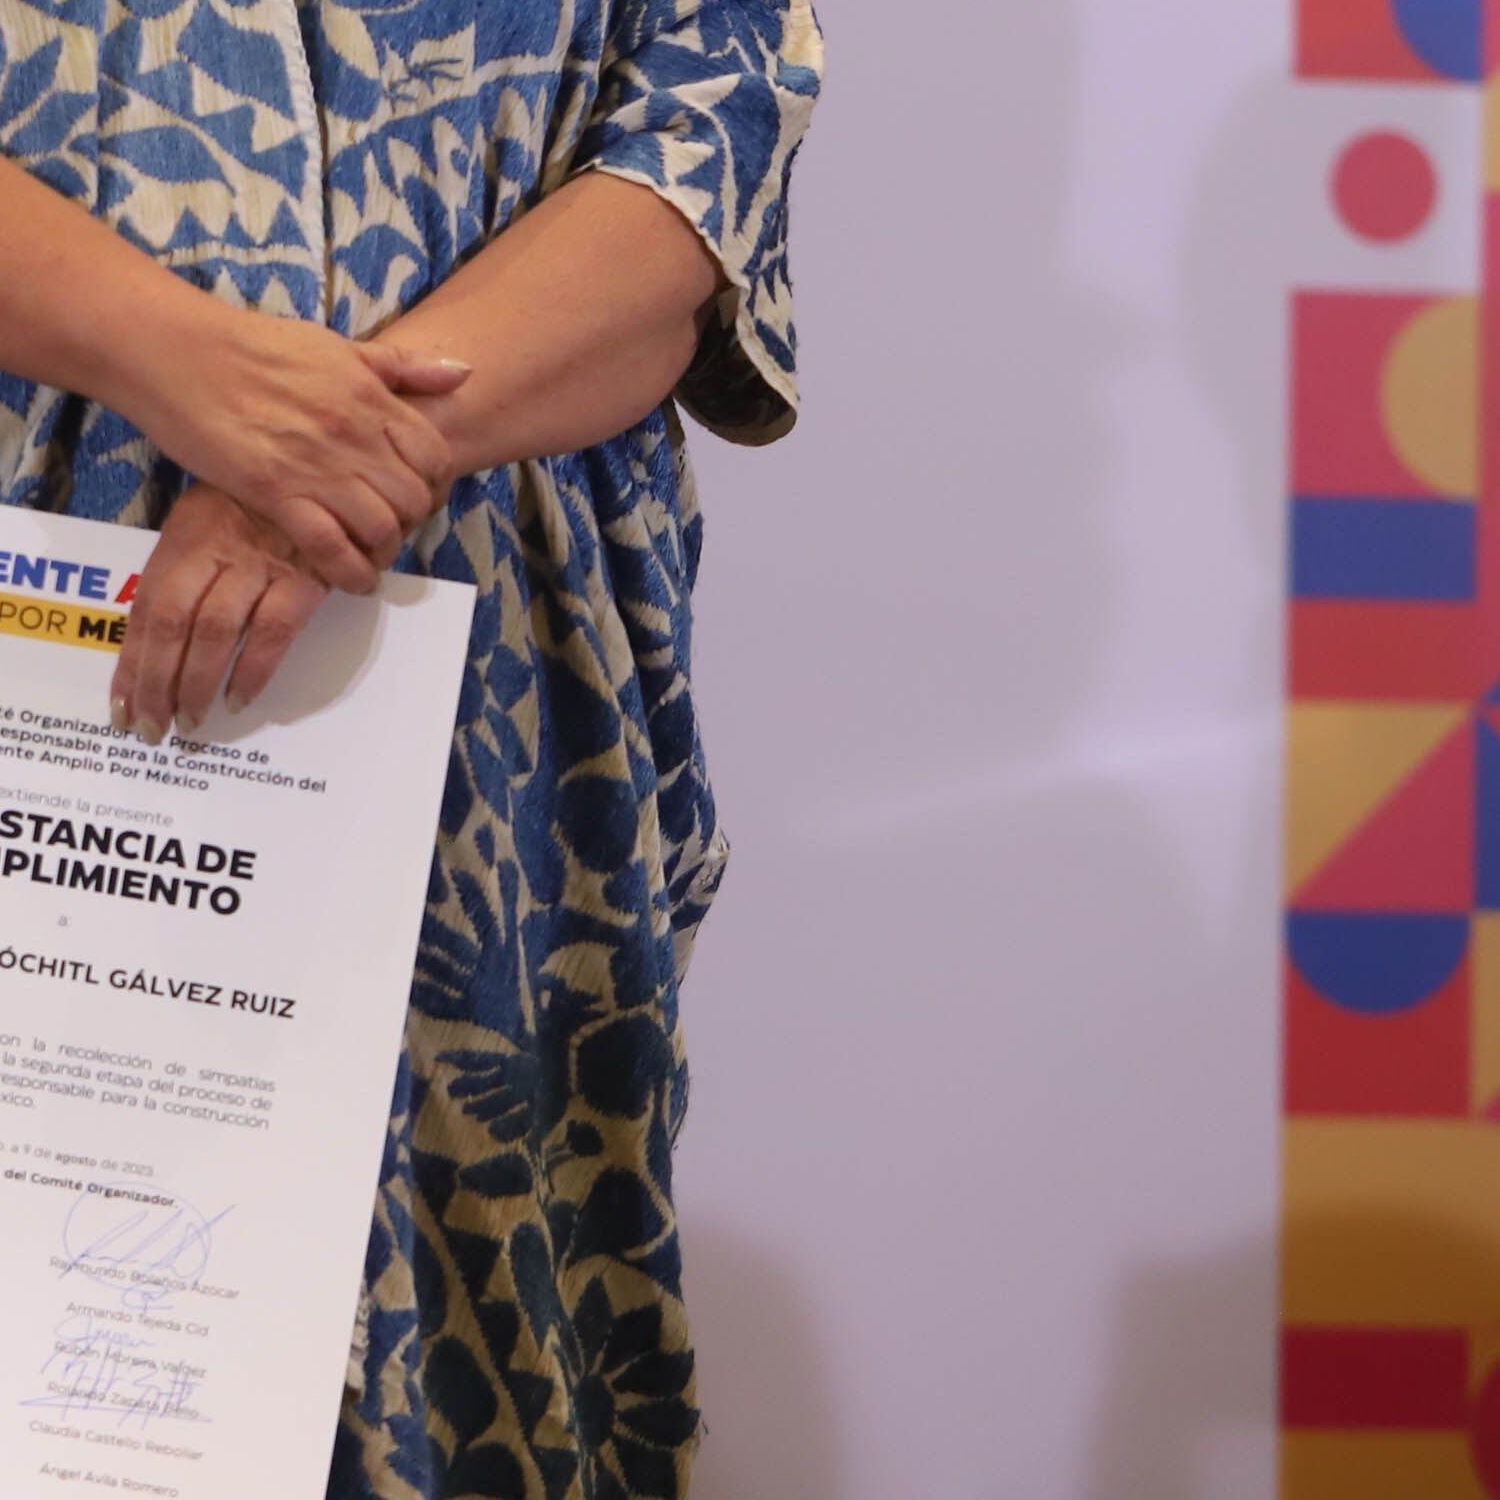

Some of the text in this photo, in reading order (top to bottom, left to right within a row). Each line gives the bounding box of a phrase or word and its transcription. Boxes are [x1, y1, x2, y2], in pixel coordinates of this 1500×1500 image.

[19, 710, 131, 741] Organizador
[169, 735, 243, 760] Proceso
[247, 748, 269, 765] de
[39, 750, 104, 773] Amplio
[109, 762, 140, 779] Por
[145, 768, 209, 792] México
[106, 746, 148, 762] para
[153, 751, 169, 766] la
[174, 755, 294, 787] Construcción
[299, 776, 326, 793] del
[75, 798, 90, 813] la
[94, 804, 173, 828] presente
[195, 842, 257, 880] DE
[108, 967, 222, 1006] GÁLVEZ
[229, 989, 296, 1019] RUIZ
[33, 1037, 46, 1052] la
[58, 1044, 152, 1070] recolección
[164, 1059, 186, 1076] de
[2, 1051, 16, 1066] la
[21, 1058, 91, 1079] segunda
[96, 1070, 143, 1090] etapa
[148, 1076, 174, 1093] del
[178, 1085, 246, 1106] proceso
[250, 1094, 272, 1110] de
[101, 1090, 137, 1106] para
[143, 1094, 157, 1109] la
[162, 1101, 269, 1129] construcción
[33, 1145, 50, 1159] de
[55, 1152, 97, 1167] agosto
[101, 1157, 117, 1171] de
[4, 1167, 27, 1181] del
[30, 1172, 83, 1191] Comité
[87, 1182, 178, 1208] Organizador.
[66, 1300, 132, 1323] Armando
